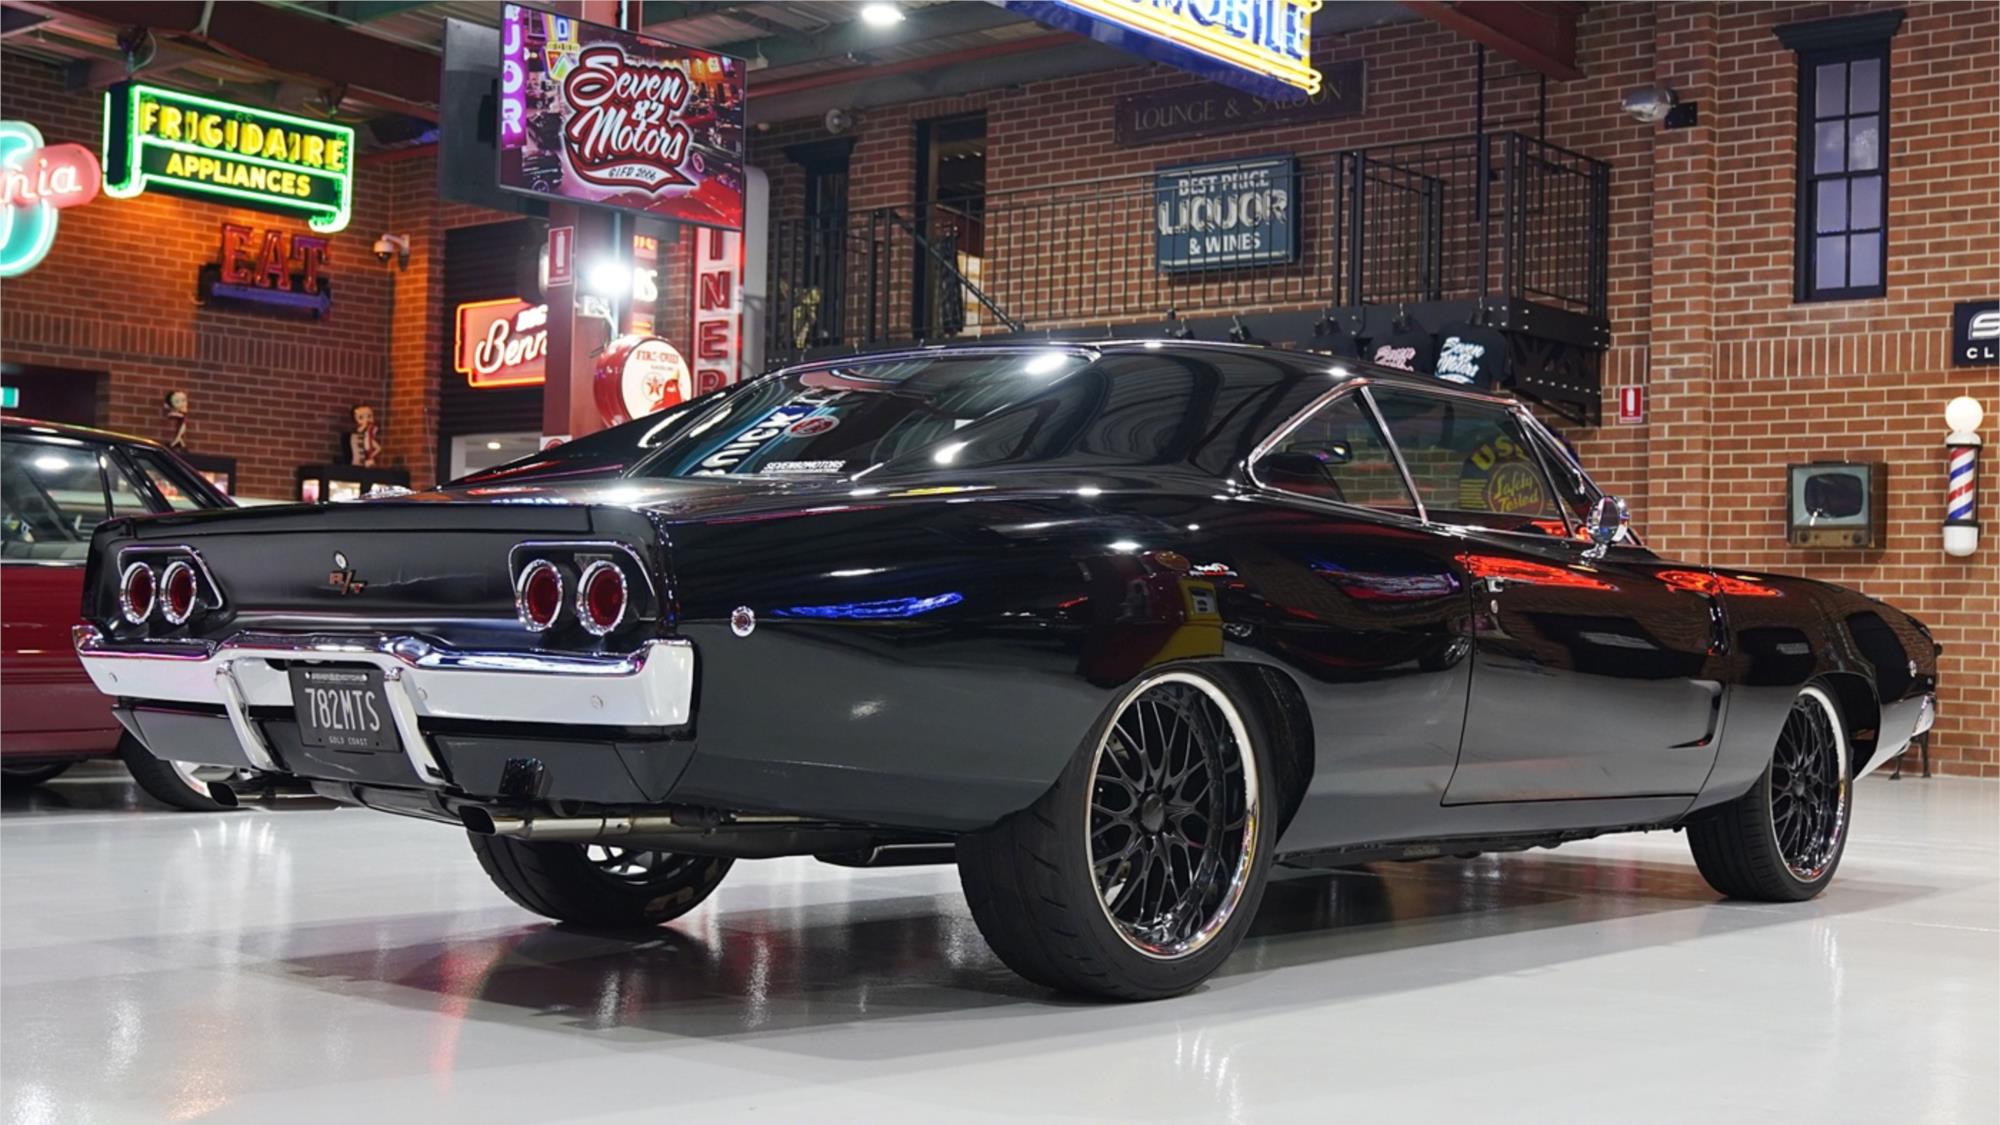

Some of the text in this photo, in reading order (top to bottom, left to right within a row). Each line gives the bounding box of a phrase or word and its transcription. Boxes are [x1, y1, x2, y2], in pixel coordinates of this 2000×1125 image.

[571, 55, 682, 107] Seven
[572, 106, 683, 160] Motors
[631, 101, 665, 124] 82
[1135, 106, 1215, 131] LOUNGE
[1224, 97, 1241, 118] &
[139, 101, 346, 171] FRIGIDAIRE
[166, 153, 311, 197] APPLIANCES
[1179, 170, 1269, 196] BEST PRICE
[1158, 189, 1287, 235] LIQUOR
[221, 223, 329, 293] EAT
[1189, 232, 1261, 256] & WINES
[304, 687, 381, 732] 782MTS
